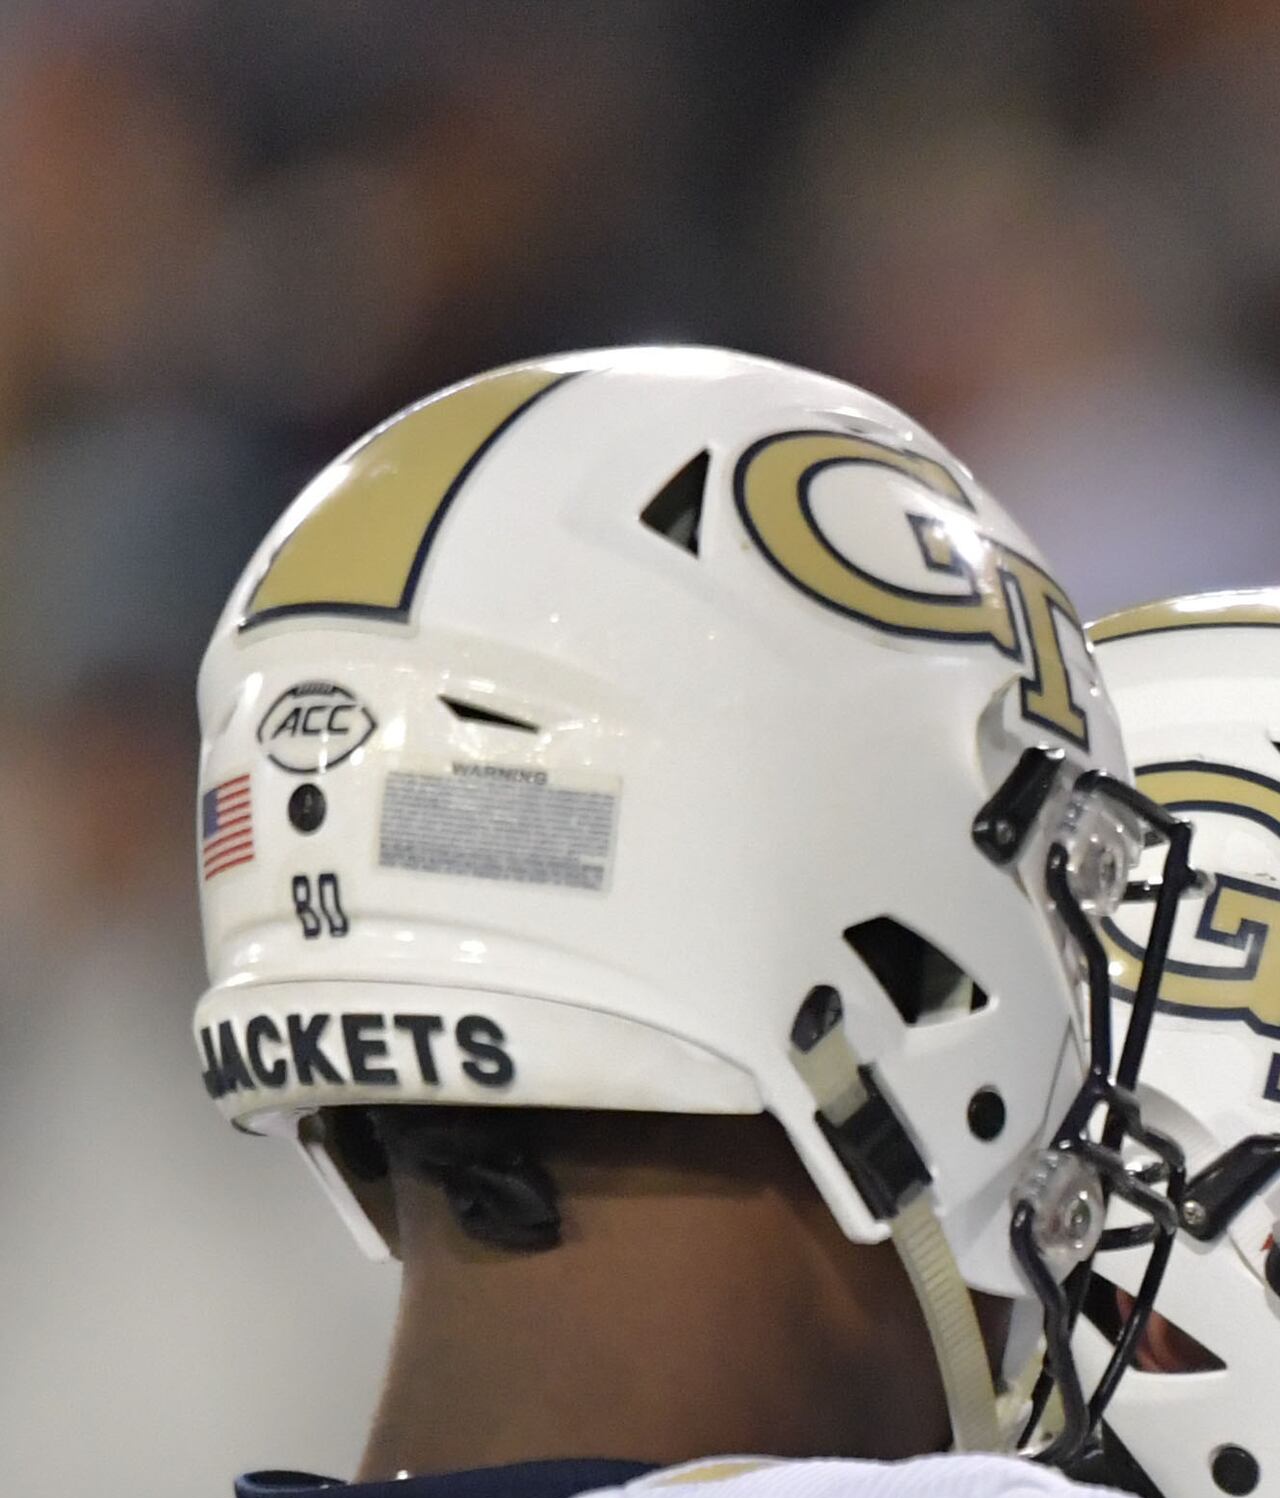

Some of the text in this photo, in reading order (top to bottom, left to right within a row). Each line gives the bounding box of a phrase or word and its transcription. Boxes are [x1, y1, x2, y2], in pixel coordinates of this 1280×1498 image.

[733, 429, 1096, 755] GT
[271, 703, 356, 738] ACC
[452, 762, 548, 785] WARNING
[292, 872, 350, 939] 80
[200, 1013, 516, 1099] JACKETS
